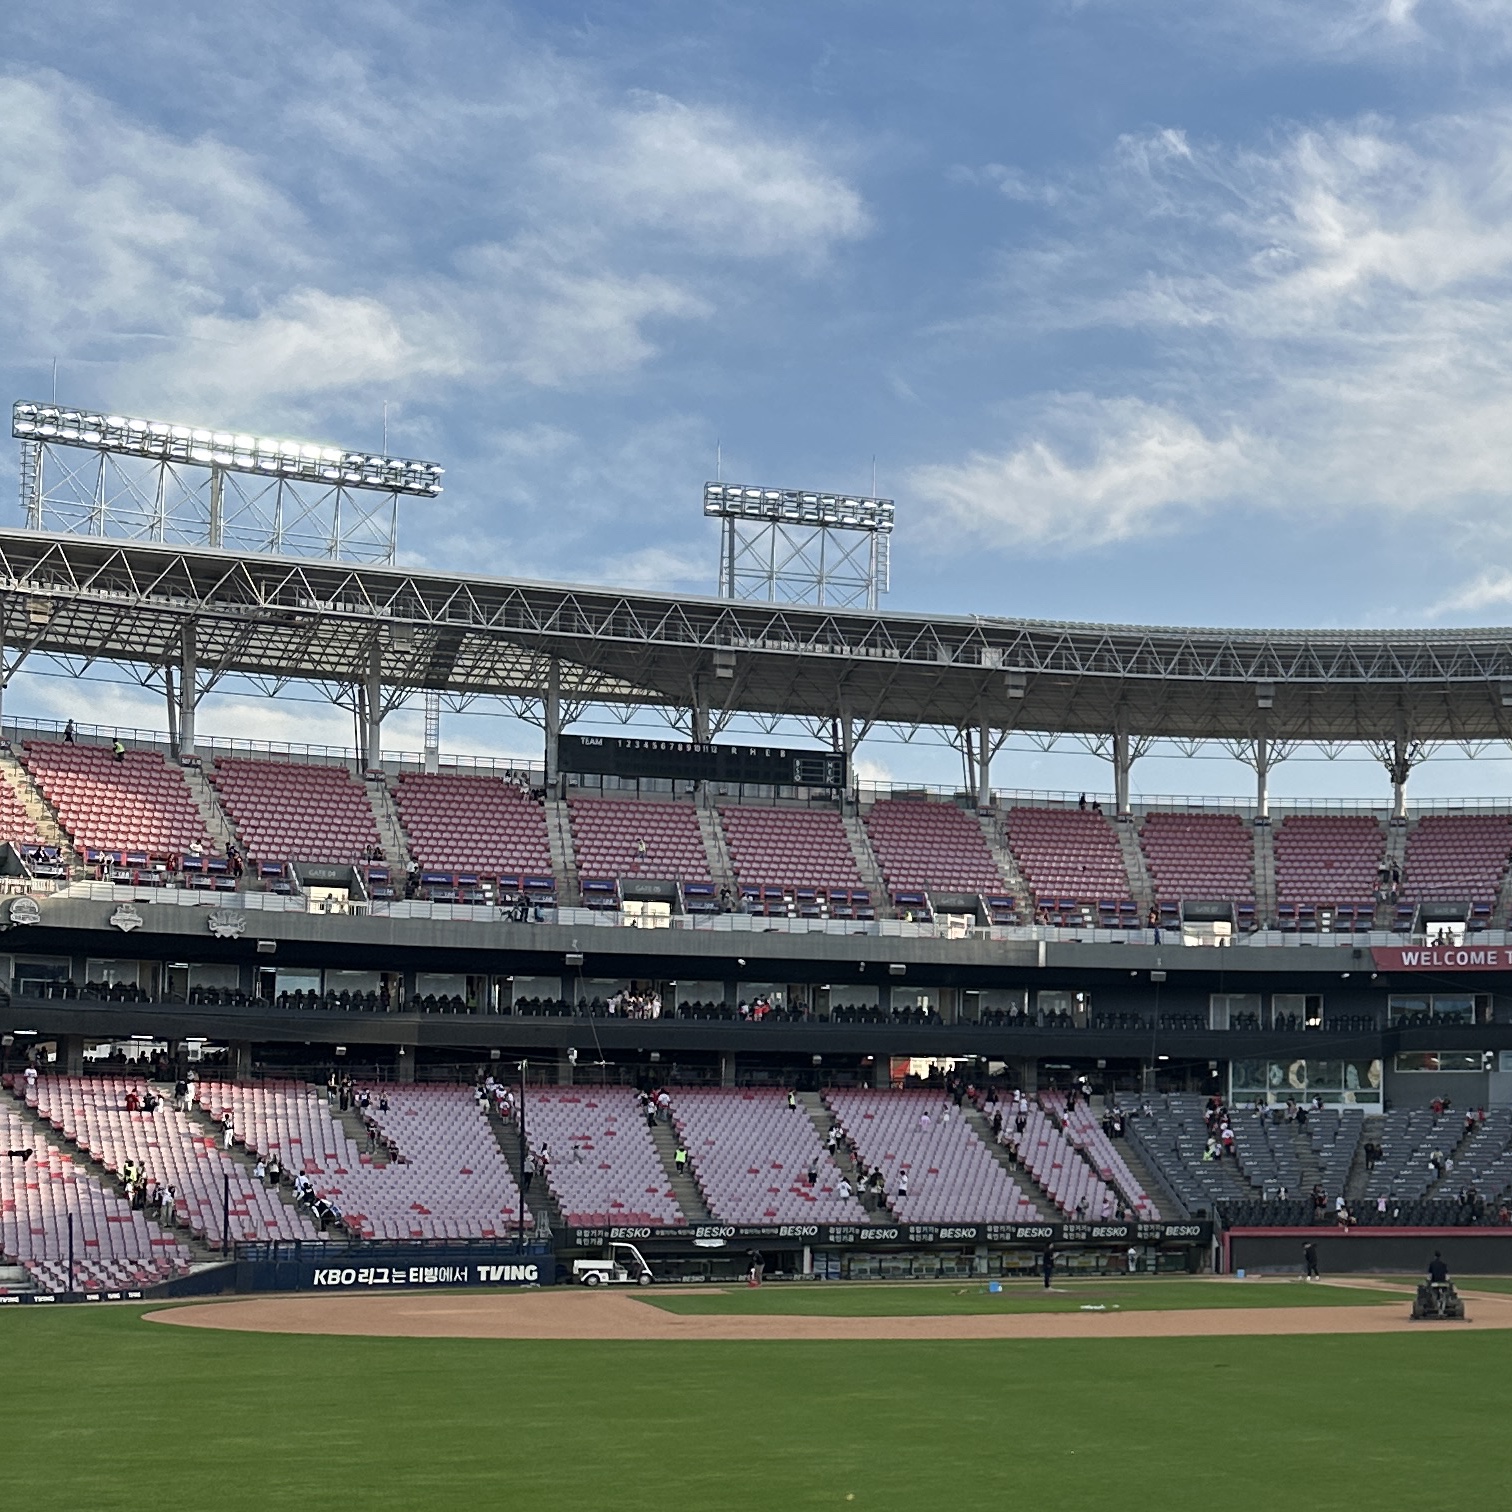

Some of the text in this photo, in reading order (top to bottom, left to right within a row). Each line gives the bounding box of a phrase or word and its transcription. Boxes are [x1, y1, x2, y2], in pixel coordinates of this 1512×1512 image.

[625, 740, 631, 748] 2
[634, 741, 640, 749] 3
[731, 746, 738, 755] R
[1401, 950, 1498, 966] WELCOME
[610, 1227, 651, 1239] BESKO
[695, 1226, 736, 1238] BESKO
[779, 1225, 818, 1237] BESKO
[860, 1228, 899, 1240] BESKO
[939, 1227, 977, 1239] BESKO
[1016, 1227, 1053, 1238] BESKO
[1091, 1226, 1128, 1237] BESKO
[1165, 1225, 1200, 1236] BESKO
[313, 1264, 539, 1286] KBO 리그는 티빙에서 TVING
